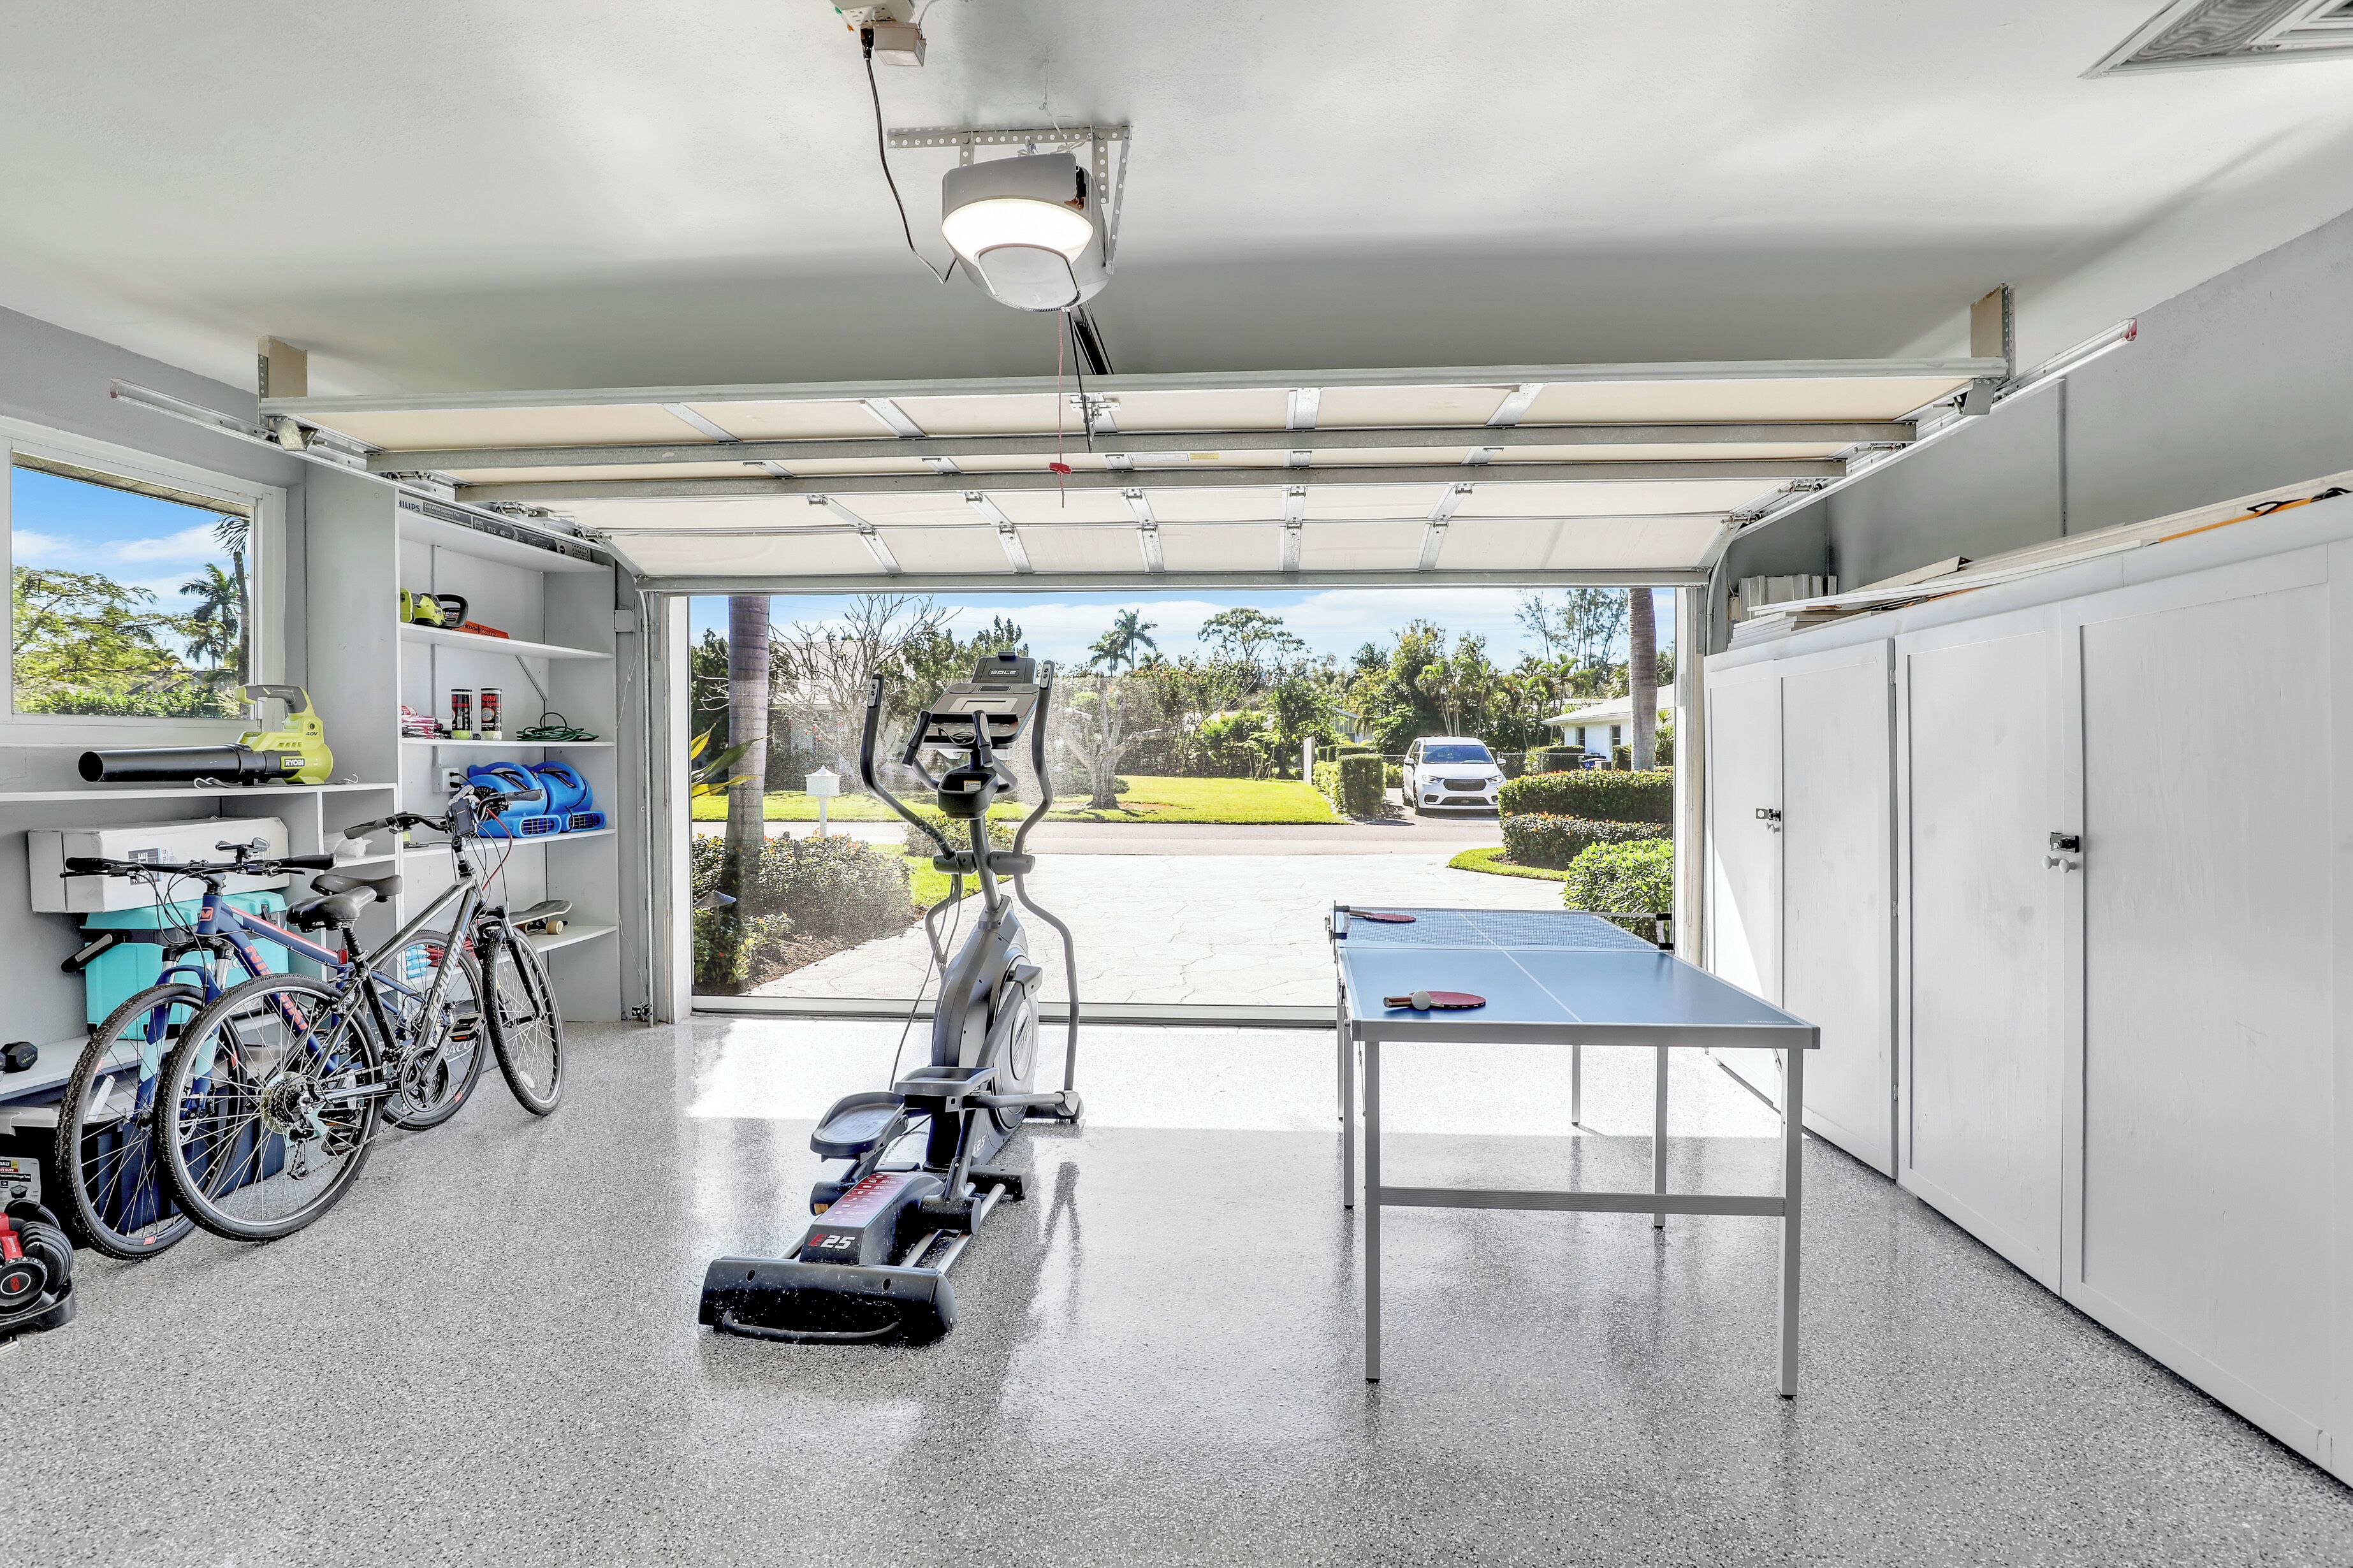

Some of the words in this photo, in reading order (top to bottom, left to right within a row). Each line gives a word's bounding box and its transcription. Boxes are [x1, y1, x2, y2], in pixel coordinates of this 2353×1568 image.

[486, 525, 496, 534] T12
[245, 945, 309, 1030] NIIKI
[428, 930, 464, 1021] SCHWINN
[808, 1233, 856, 1250] E25
